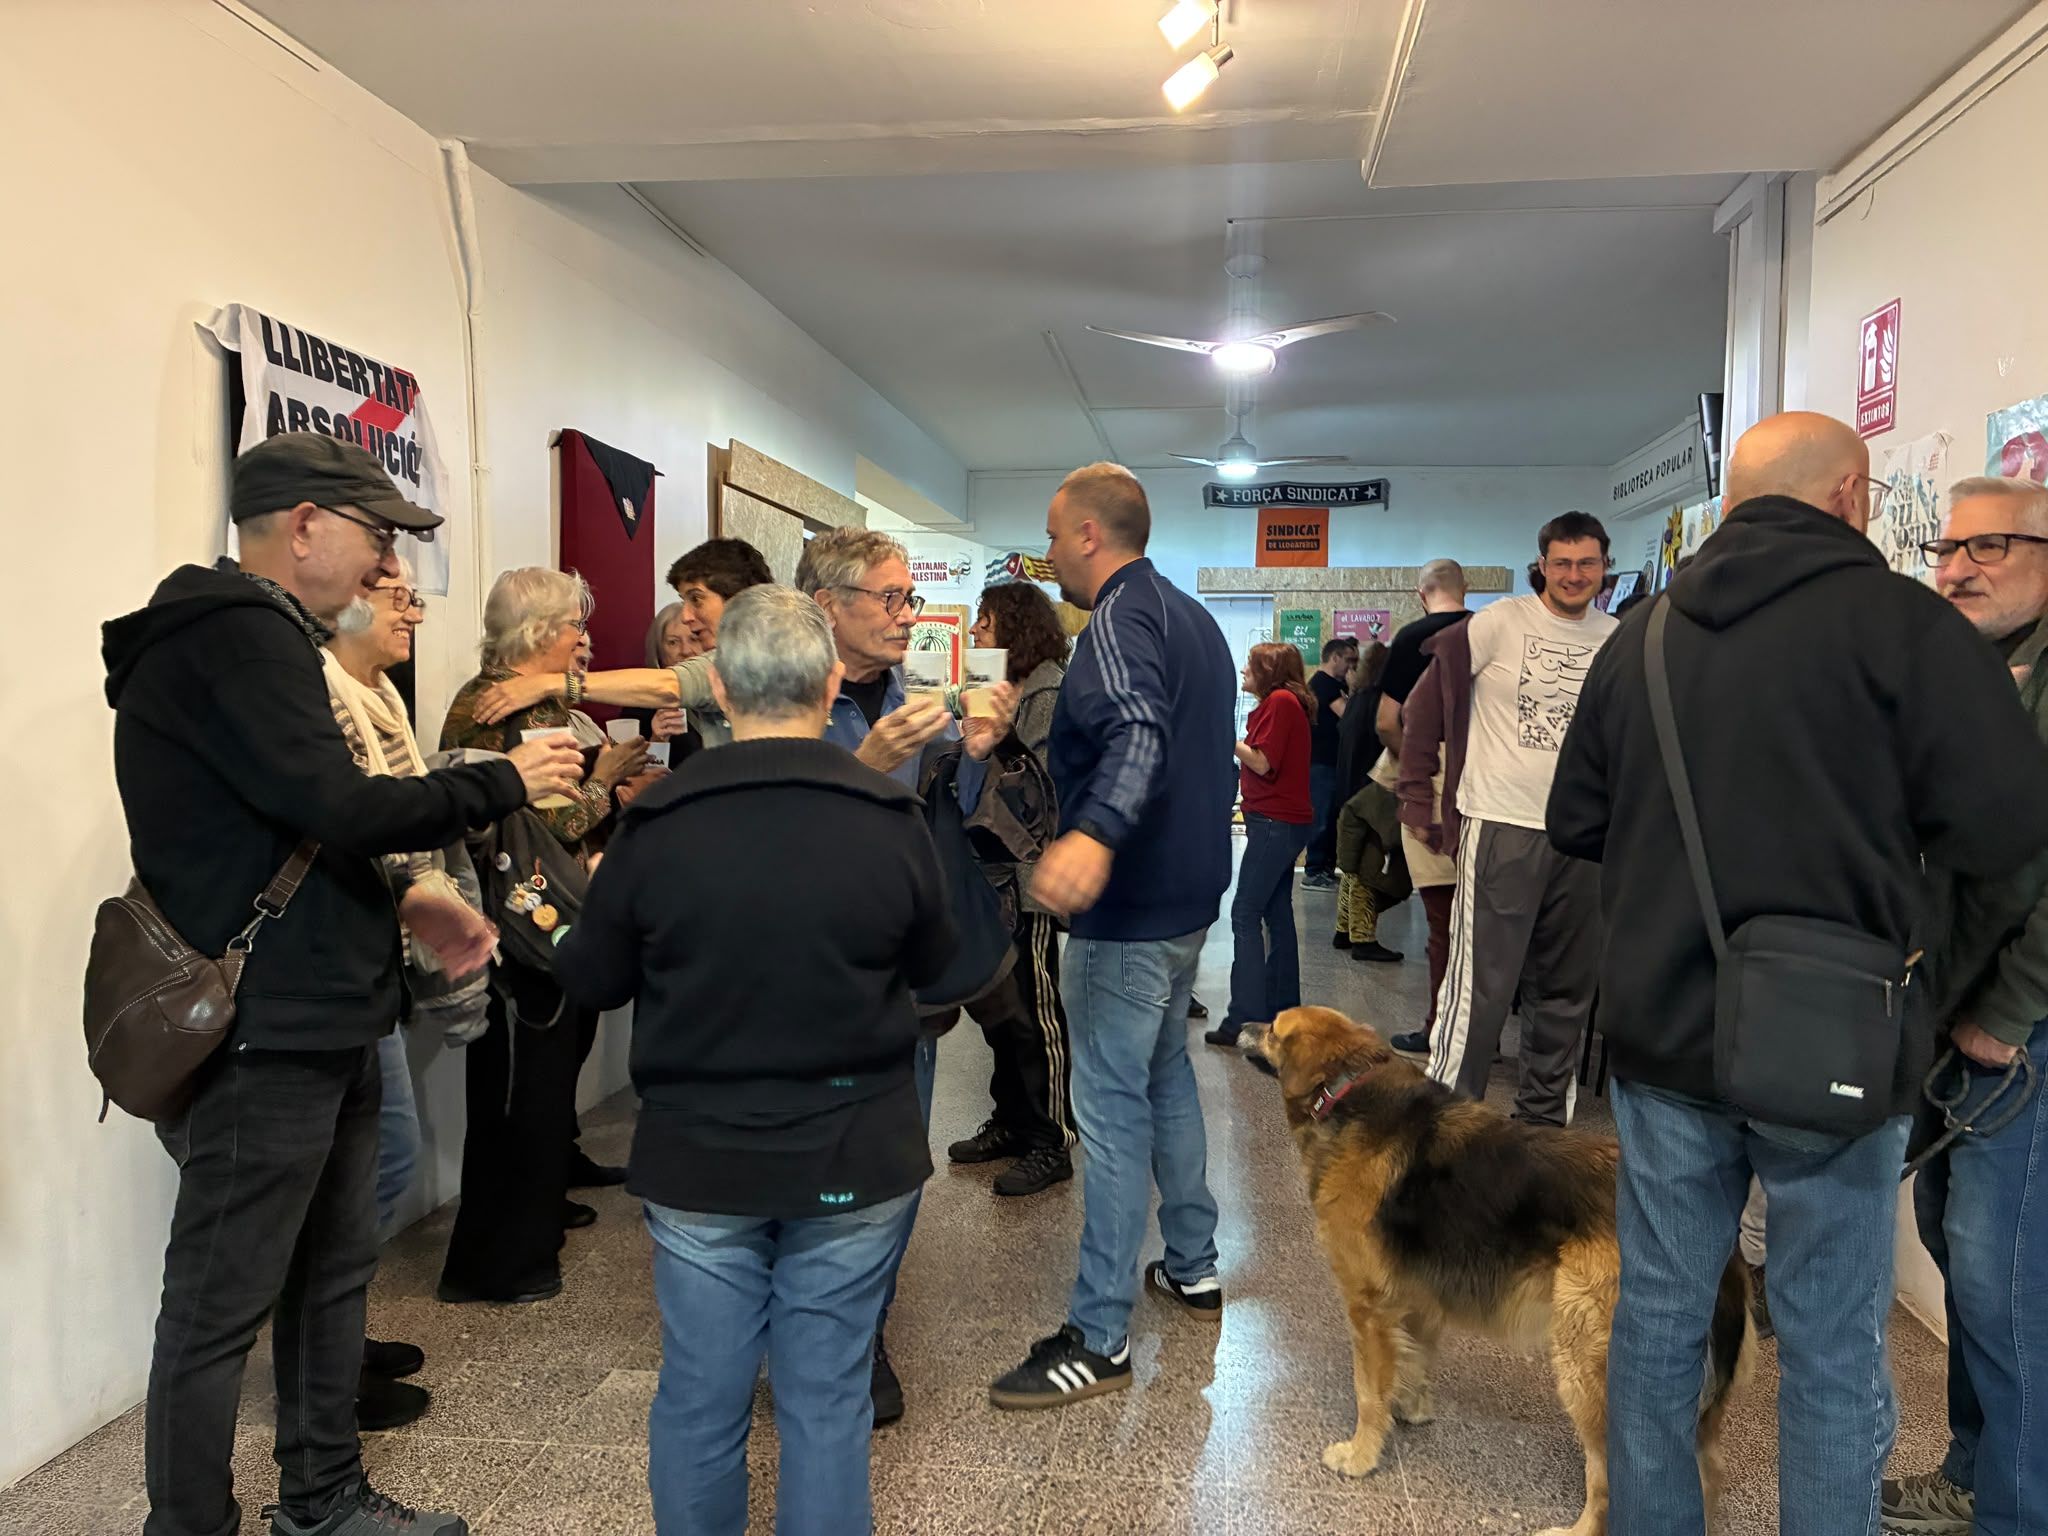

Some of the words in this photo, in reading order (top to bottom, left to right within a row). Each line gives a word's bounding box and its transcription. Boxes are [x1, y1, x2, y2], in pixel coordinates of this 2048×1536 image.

[1613, 468, 1654, 501] BIBLIOTECA
[1655, 446, 1693, 481] POPULAR
[1231, 487, 1283, 504] FORÇA
[1286, 486, 1360, 501] SINDICAT
[1266, 524, 1321, 537] SINDICAT
[912, 561, 948, 571] CATALANS
[911, 571, 948, 582] ALESTINA
